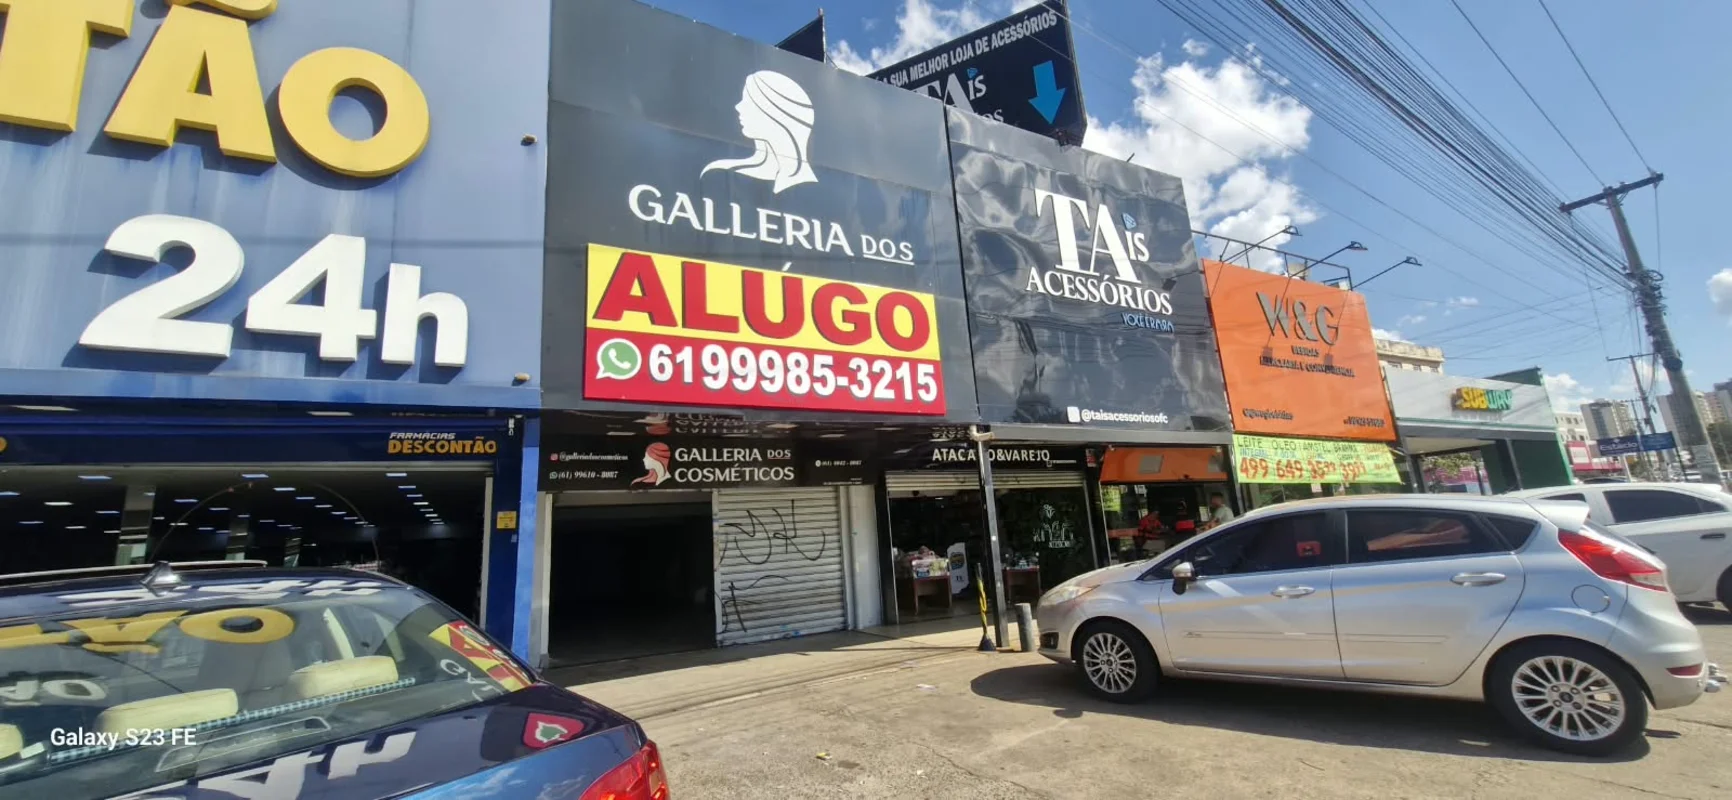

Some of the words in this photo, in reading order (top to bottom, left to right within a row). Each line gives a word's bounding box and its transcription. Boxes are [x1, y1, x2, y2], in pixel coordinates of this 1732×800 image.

[909, 53, 949, 81] MELHOR
[949, 45, 975, 64] LOJA
[974, 38, 991, 55] DE
[990, 11, 1058, 49] ACESSÓRIOS
[628, 184, 855, 257] GALLERIA
[860, 234, 915, 265] DOS
[79, 213, 469, 368] 24h
[592, 251, 931, 352] ALUGO
[1026, 265, 1173, 316] ACESSÓRIOS
[1255, 291, 1340, 346] W&G
[1458, 386, 1513, 412] SUBWAY
[1081, 408, 1169, 424] @taisacessoriosofc
[387, 436, 497, 454] DESCONTÃO
[674, 447, 763, 462] GALLERIA
[767, 449, 791, 460] DOS
[932, 448, 1050, 463] ATACAO&VAREJO
[1236, 437, 1263, 449] LEITE
[674, 463, 795, 483] COSMÉTICOS
